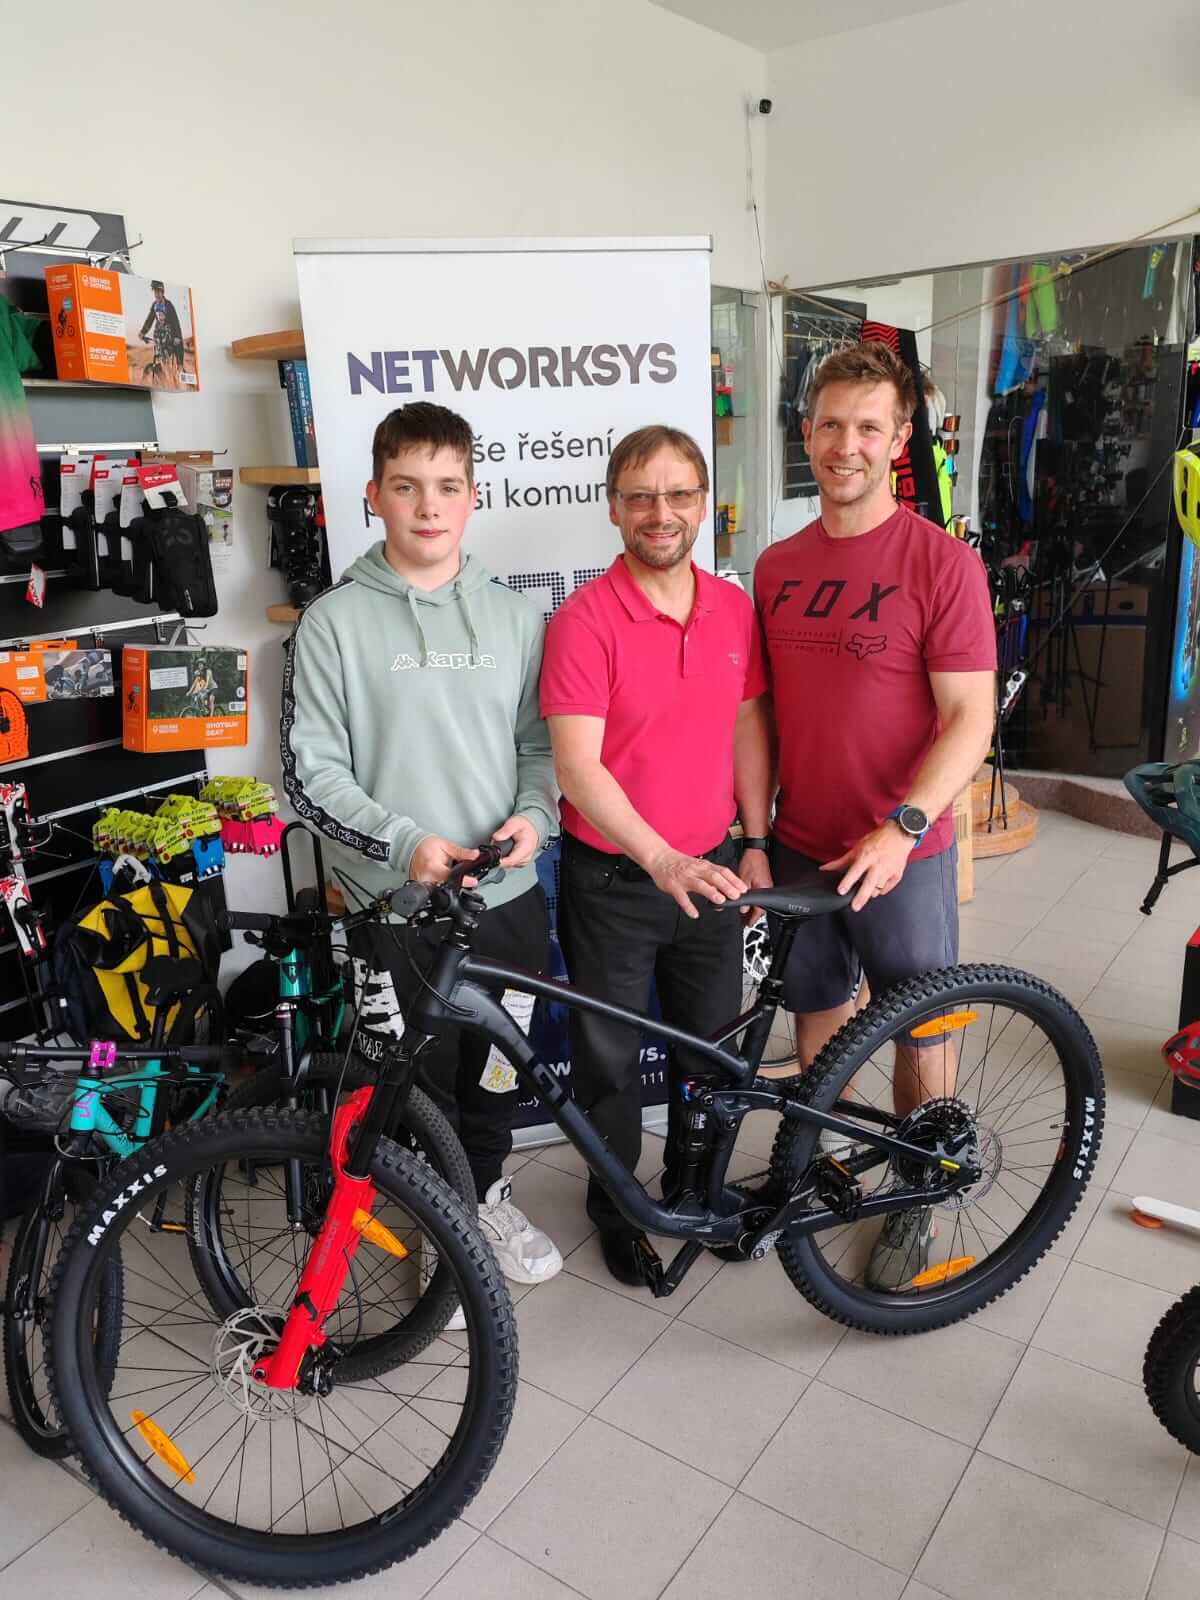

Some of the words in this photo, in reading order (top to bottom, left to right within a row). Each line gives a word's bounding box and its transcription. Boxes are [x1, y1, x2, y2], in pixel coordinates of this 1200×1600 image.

[347, 342, 677, 395] NETWORKSYS
[473, 434, 506, 463] še
[518, 428, 614, 461] řešení
[504, 477, 608, 508] komun
[770, 580, 901, 622] FOX
[1072, 1096, 1096, 1180] MAXXIS
[87, 1164, 168, 1247] MAXXIS
